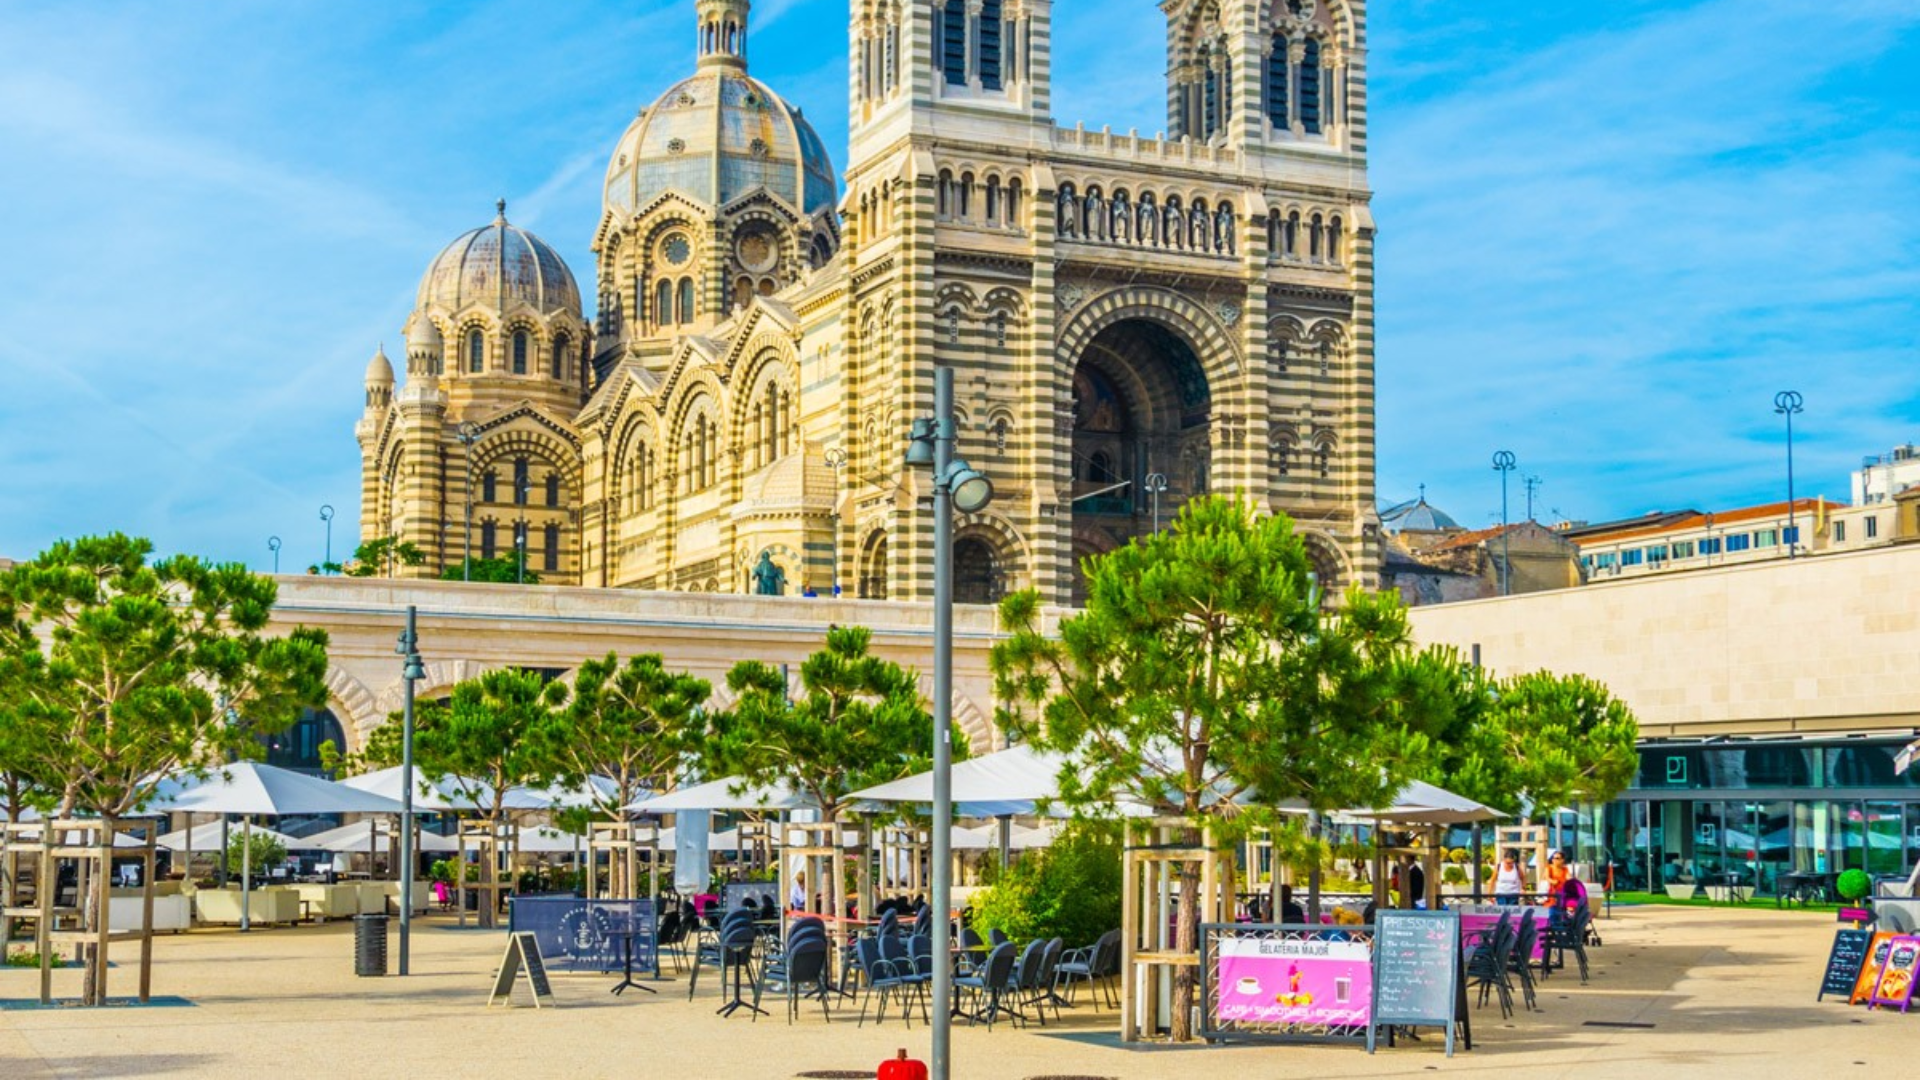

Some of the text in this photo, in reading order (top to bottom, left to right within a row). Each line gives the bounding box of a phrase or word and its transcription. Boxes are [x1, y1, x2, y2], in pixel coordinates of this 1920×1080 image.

[1383, 916, 1446, 930] PRESSION
[1259, 942, 1329, 956] GELATERIA MAJOR
